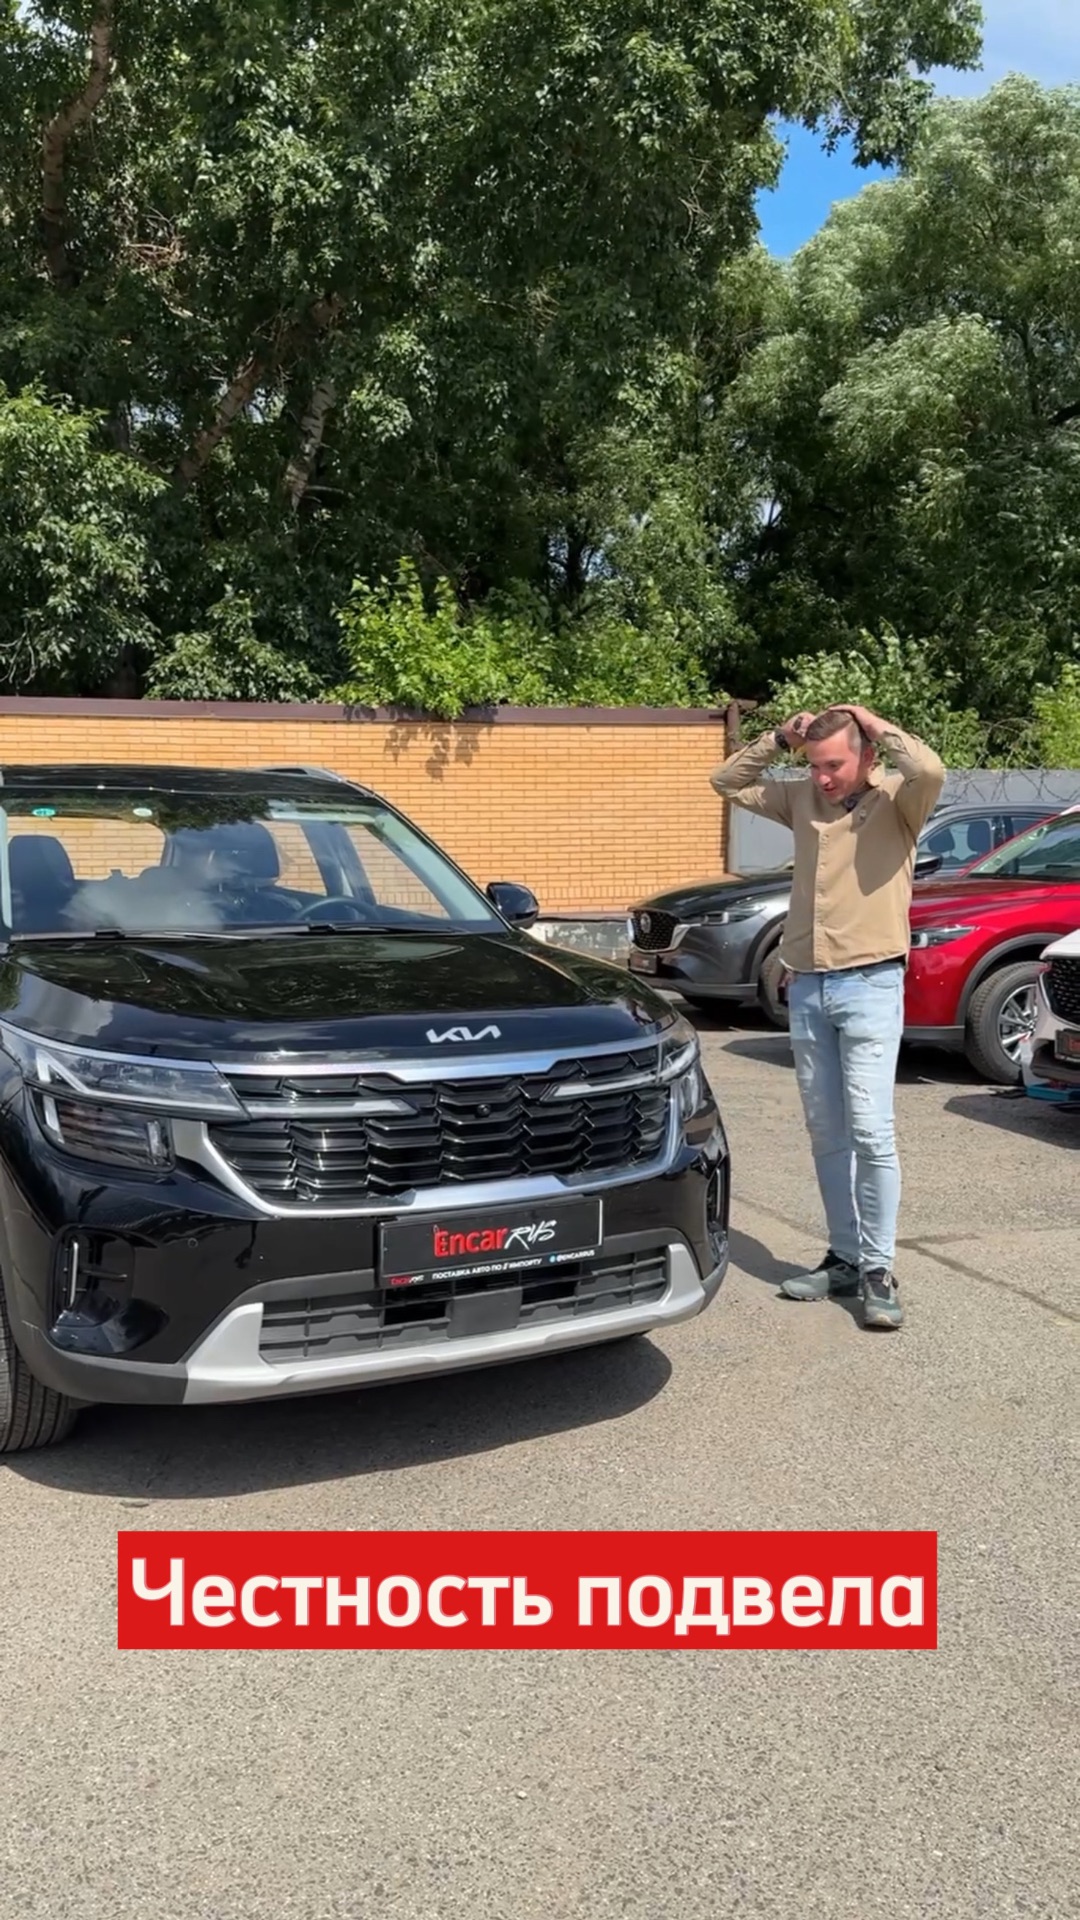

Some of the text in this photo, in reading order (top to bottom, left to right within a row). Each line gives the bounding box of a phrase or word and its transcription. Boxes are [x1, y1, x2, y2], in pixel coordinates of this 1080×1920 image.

[432, 1269, 471, 1280] ПОСТАВКА
[472, 1265, 491, 1274] АВТО
[491, 1263, 502, 1271] ПО
